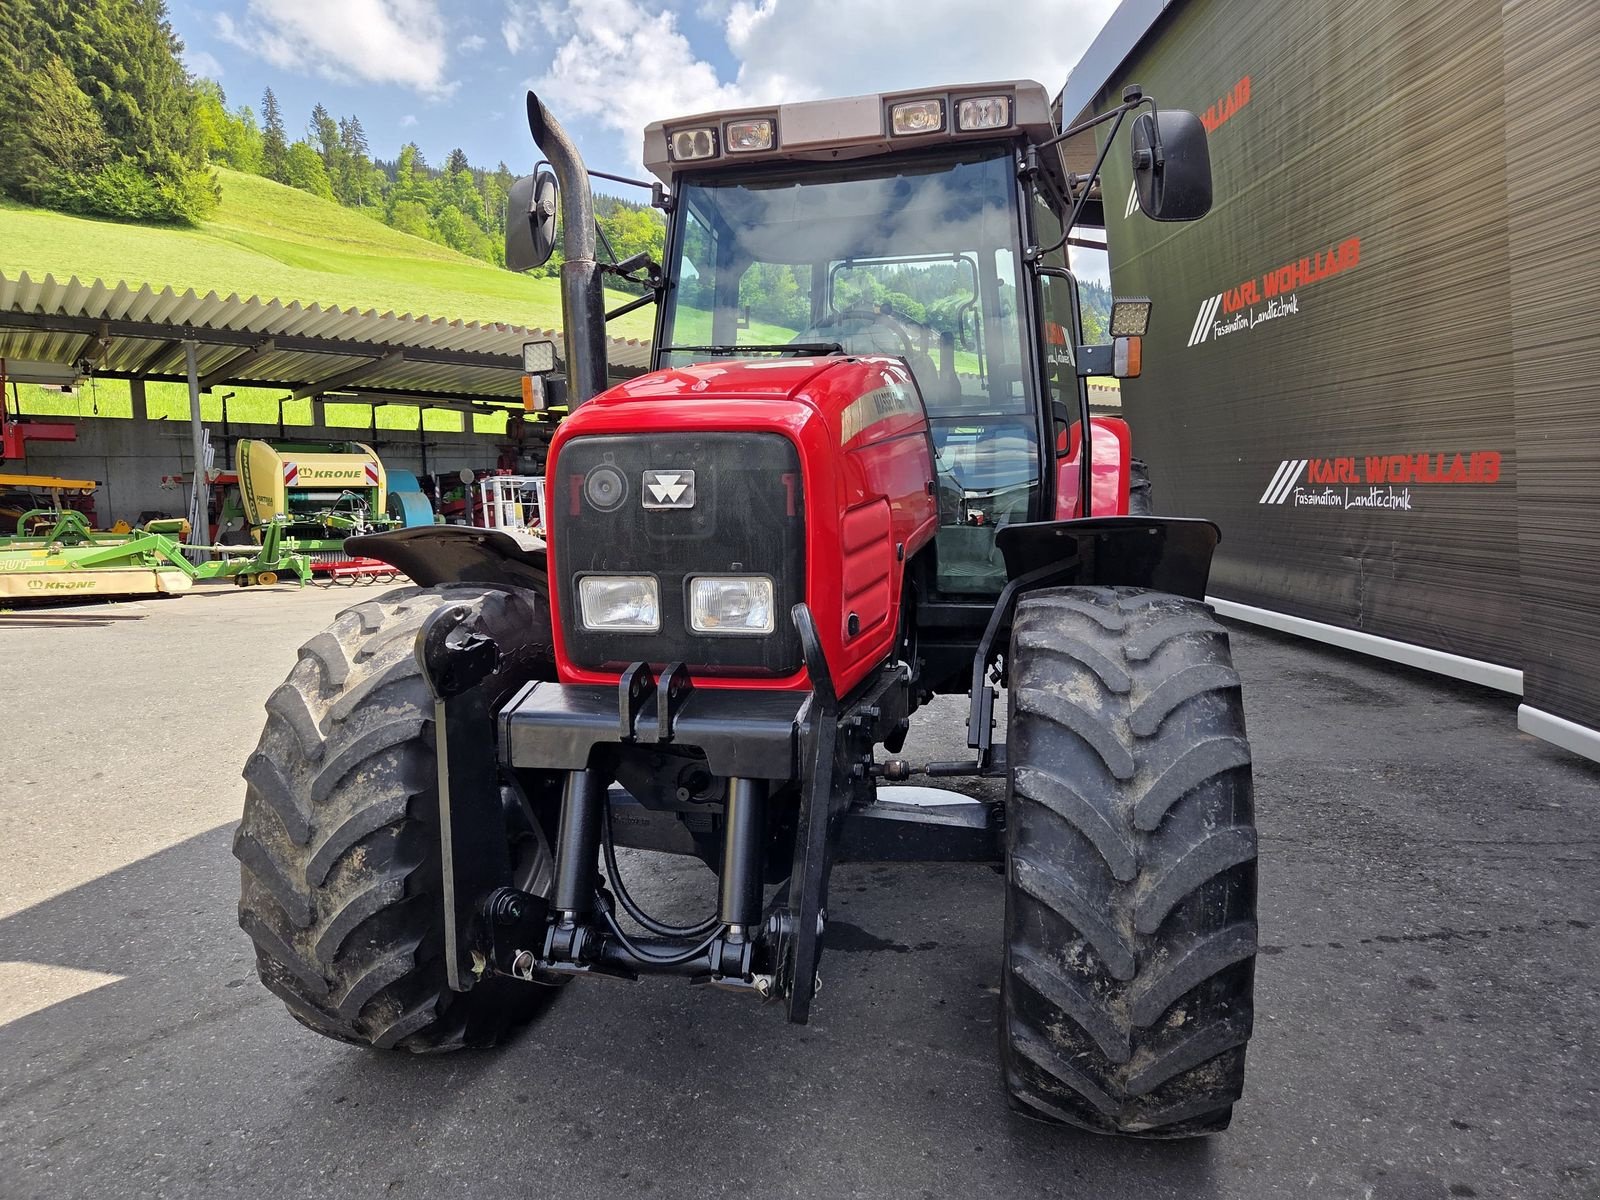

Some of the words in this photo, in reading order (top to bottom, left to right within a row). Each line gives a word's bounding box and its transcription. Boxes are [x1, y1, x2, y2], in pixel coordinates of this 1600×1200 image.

[1200, 74, 1250, 135] HLLAIB
[1223, 279, 1261, 315] KARL
[1263, 235, 1361, 299] WOHLLAIB
[1213, 313, 1249, 340] Faszination
[1250, 293, 1299, 329] Landtechnik
[315, 470, 361, 478] KRONE
[1308, 457, 1361, 484] KARL
[1365, 451, 1502, 484] WOHLLAIB
[1294, 486, 1342, 507] Faszination
[1345, 486, 1412, 510] Landtechnik
[45, 581, 96, 590] KRONE
